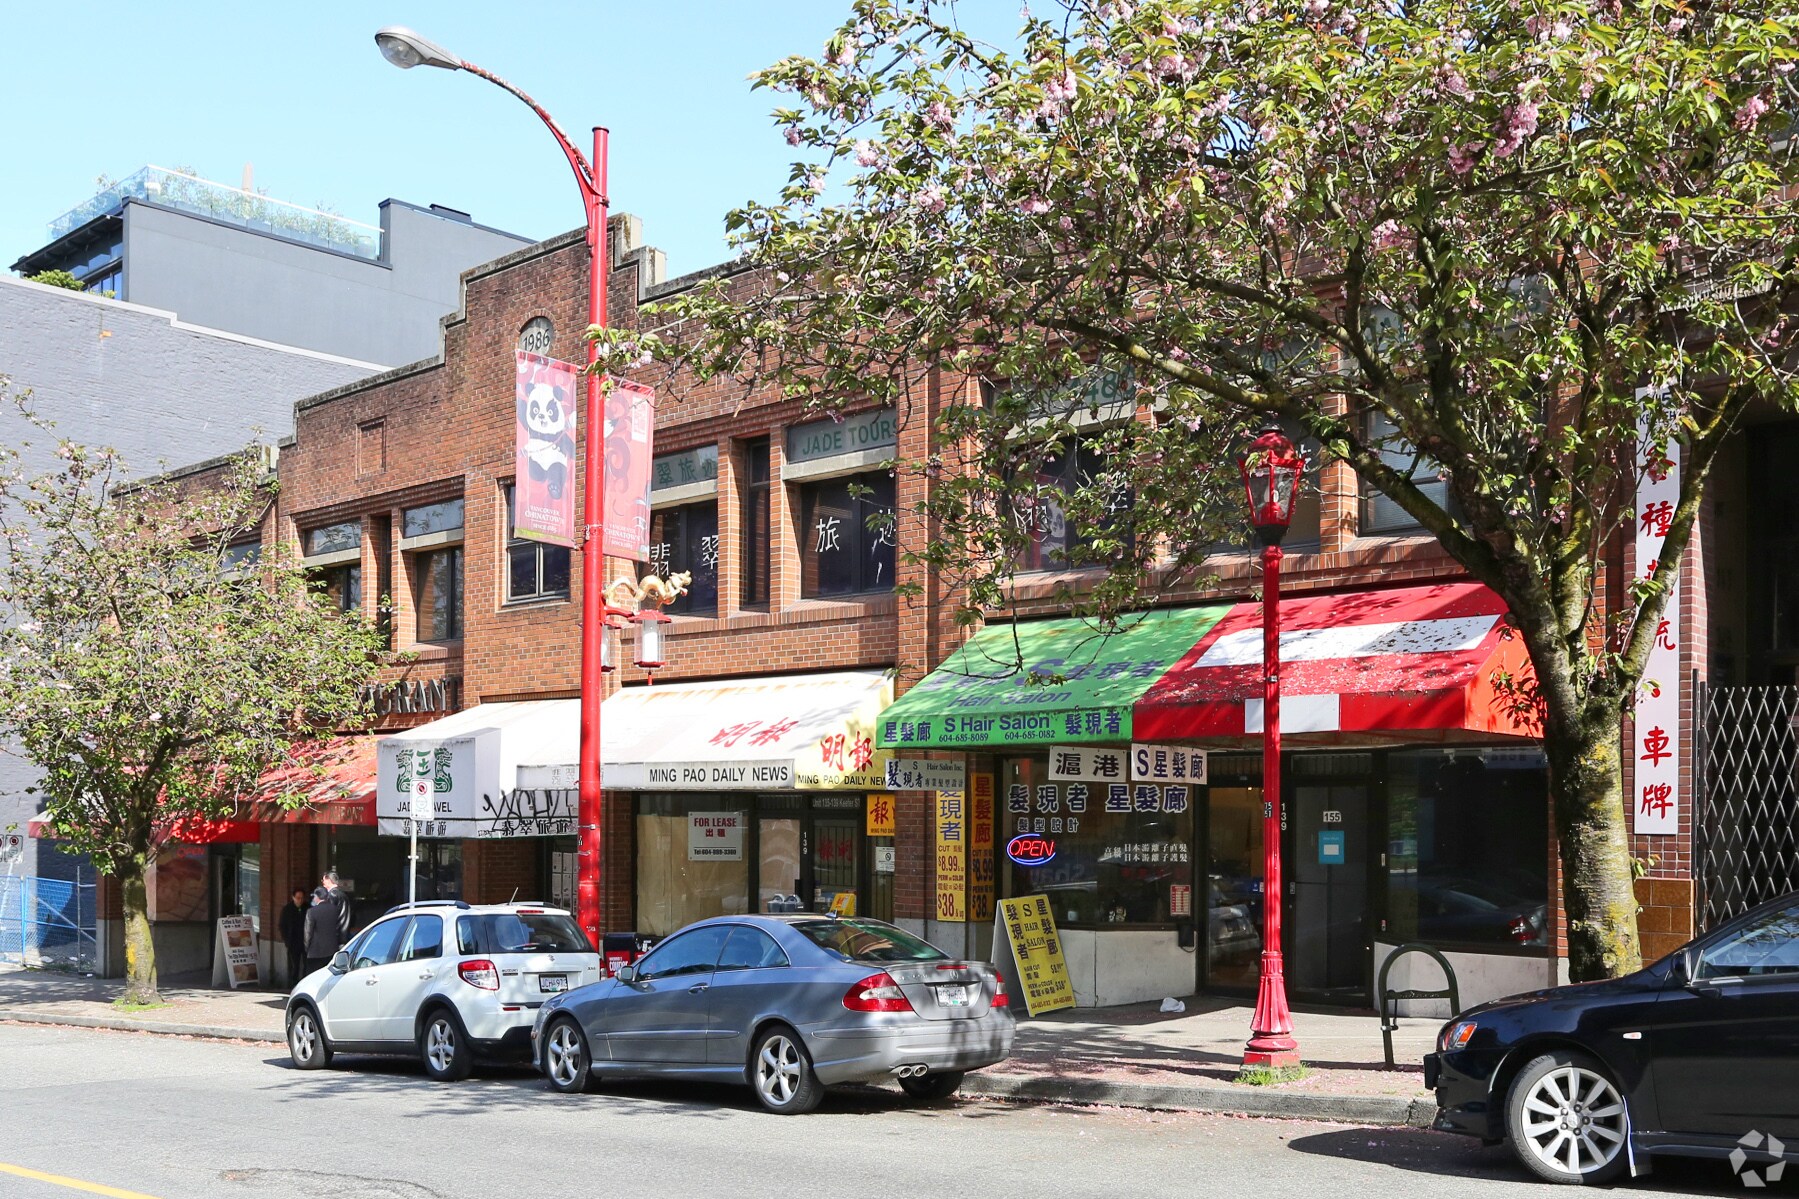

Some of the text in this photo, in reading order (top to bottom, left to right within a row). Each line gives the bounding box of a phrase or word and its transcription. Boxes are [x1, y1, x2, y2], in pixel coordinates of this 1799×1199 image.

[522, 328, 550, 352] 1986
[803, 418, 897, 455] JADE TOURS
[525, 511, 564, 524] CHINATOWN
[604, 528, 641, 542] CHINATOWN
[948, 691, 1073, 708] Hair Salon
[944, 713, 1051, 733] S Hair Salon
[1065, 711, 1122, 736] 髮現者
[884, 721, 931, 743] 星髮廊
[938, 730, 1056, 743] 604-685-8089 604-685-0182
[820, 730, 873, 773] 明報
[926, 763, 938, 771] Hair
[939, 763, 953, 771] Salon
[1137, 749, 1203, 780] S星髮廊
[649, 766, 788, 783] MING PAO DAILY NEWS
[797, 775, 886, 786] MING PAO DAILY NEW
[888, 761, 924, 788] 髮現者
[1008, 784, 1188, 814] 髮現者 星髮廊
[694, 817, 737, 827] FOR LEASE
[1017, 817, 1080, 833] 髮型設計
[1324, 812, 1341, 821] 155
[1009, 839, 1056, 858] OPEN
[938, 855, 958, 872] $8.99
[938, 893, 954, 917] $38
[1022, 903, 1032, 917] S
[1024, 922, 1039, 931] HAIR
[1027, 937, 1046, 947] SALON
